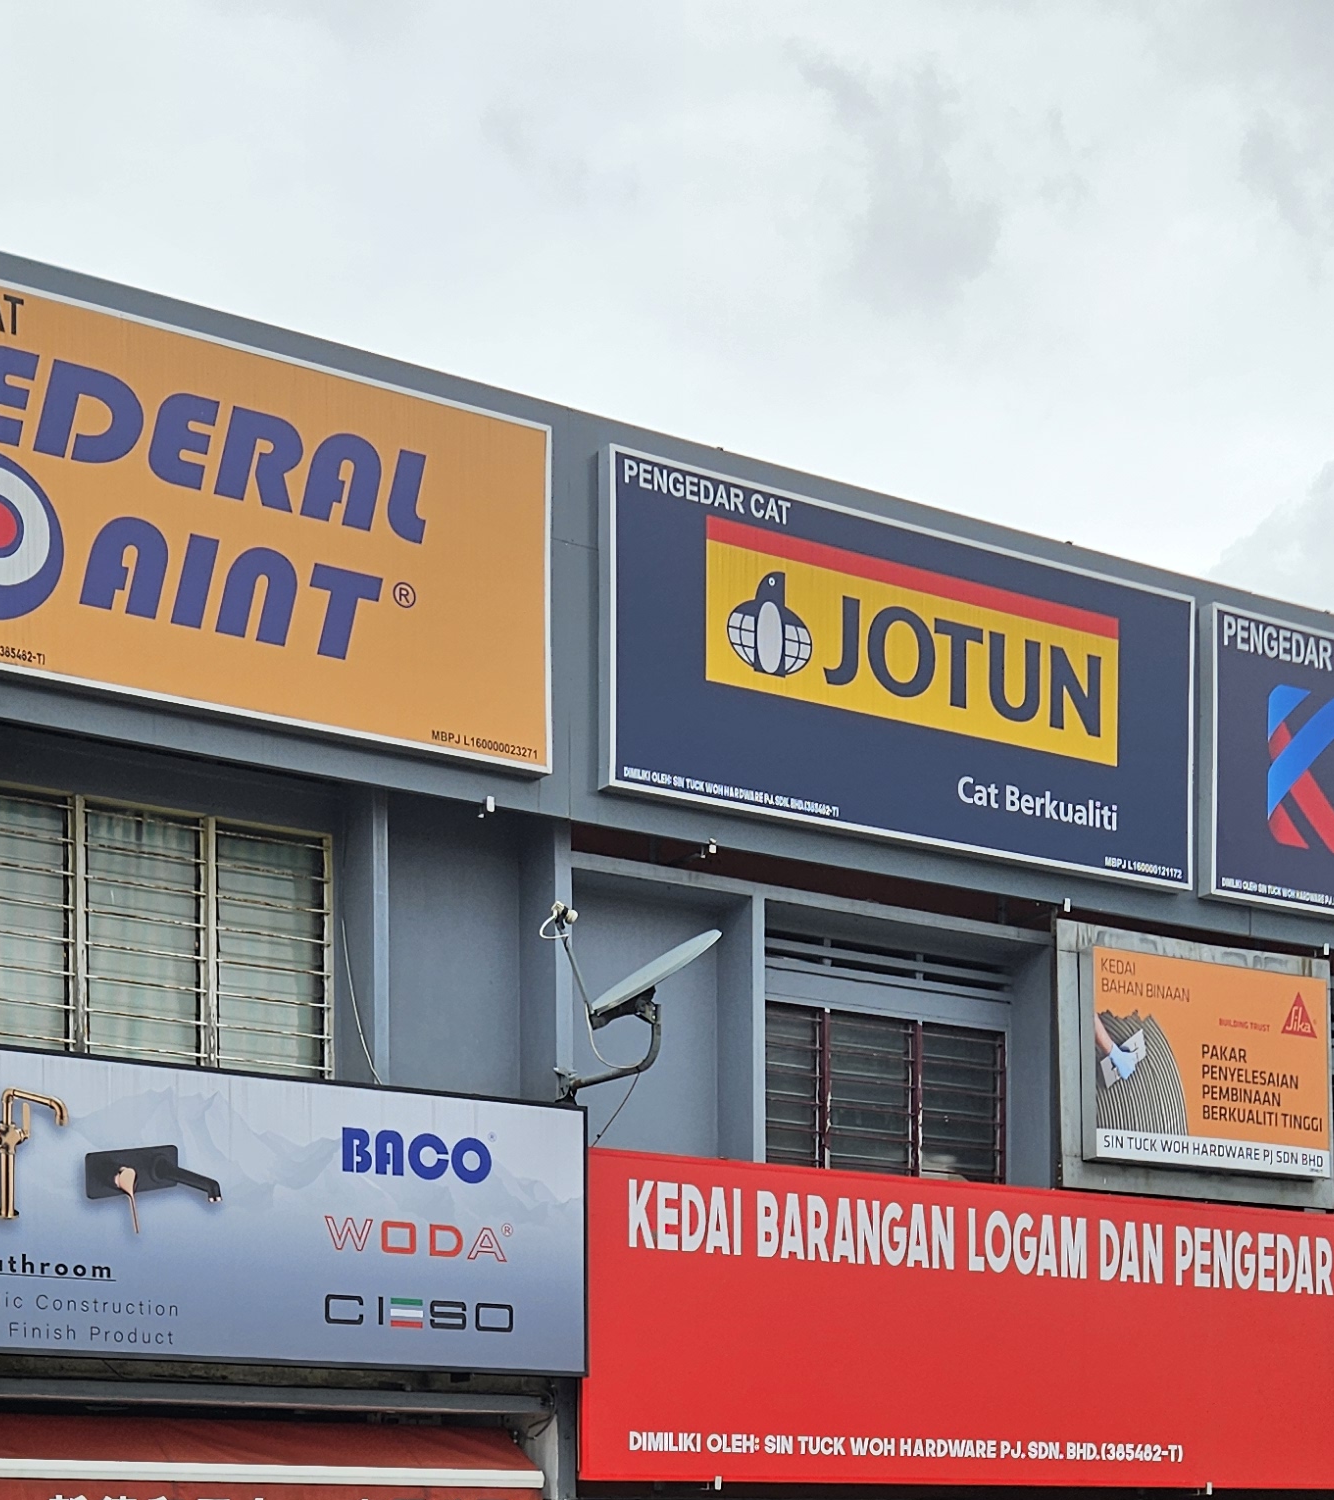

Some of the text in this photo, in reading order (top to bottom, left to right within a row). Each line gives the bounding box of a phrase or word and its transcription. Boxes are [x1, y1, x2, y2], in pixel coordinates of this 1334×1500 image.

[623, 458, 792, 526] PENGEDAR CAT
[1223, 615, 1332, 673] PENGEDAR
[823, 595, 1101, 738] JOTUN
[957, 775, 1118, 832] Cat Berkualiti
[1101, 957, 1136, 976] KEDAI
[1101, 977, 1190, 1002] BAHAN BINAAN
[1249, 1022, 1270, 1032] TRUST
[1286, 1006, 1311, 1033] Sika
[1201, 1044, 1247, 1064] PAKAR
[1201, 1064, 1299, 1090] PENYELESAIAN
[1201, 1084, 1281, 1108] PEMBINAAN
[1202, 1104, 1323, 1132] BERKUALITI TINGGI
[342, 1127, 492, 1184] BACO
[1103, 1134, 1323, 1168] SIN TUCK WOH HARDWARE PJ SDN BHD
[324, 1215, 507, 1263] WODA
[627, 1178, 743, 1256] KEDAI
[757, 1193, 955, 1271] BARANGAN
[966, 1208, 1087, 1281] LOGAM
[1099, 1217, 1164, 1286] DAN
[1175, 1224, 1334, 1296] PENGEDAR
[35, 1294, 179, 1317] Construction
[9, 1322, 76, 1341] Finish
[90, 1328, 174, 1345] Product
[627, 1430, 701, 1454] DIMILIKI
[706, 1433, 760, 1455] OLEH:
[764, 1435, 793, 1456] SIN
[798, 1435, 845, 1456] TUCK
[850, 1437, 895, 1458] WOH
[899, 1439, 997, 1461] HARDWARE
